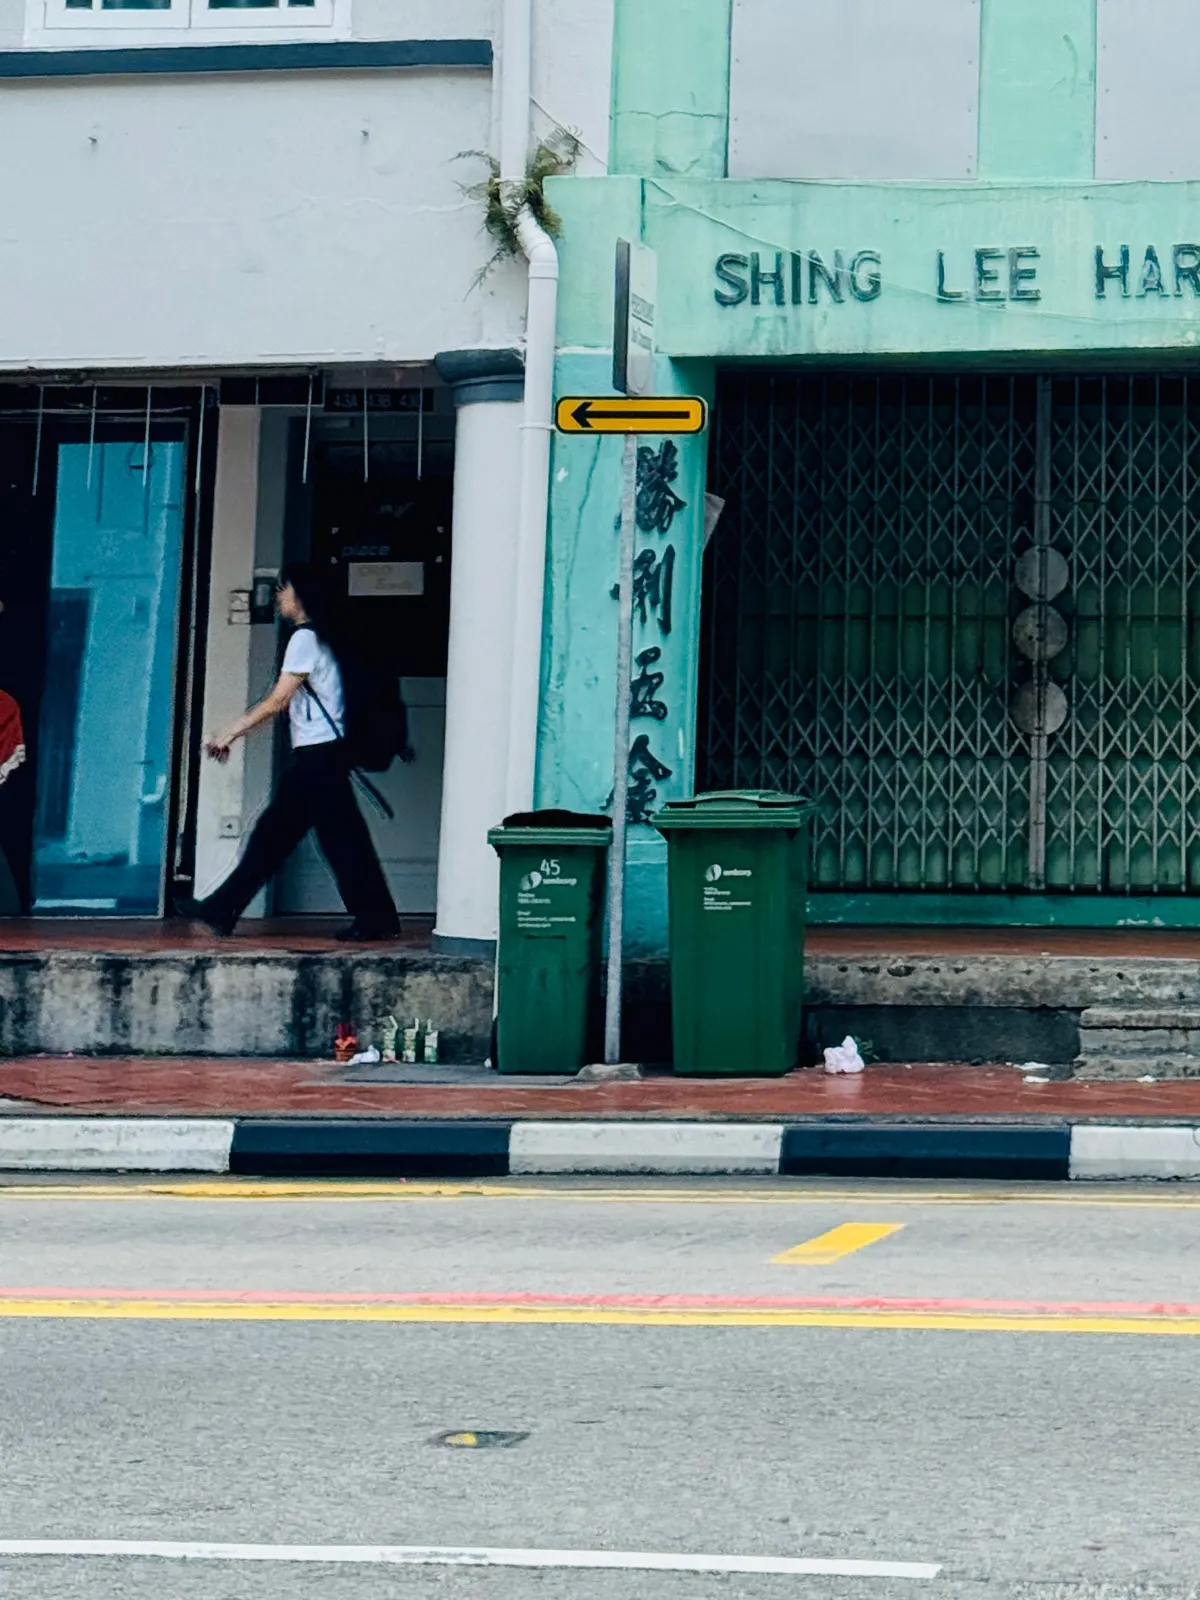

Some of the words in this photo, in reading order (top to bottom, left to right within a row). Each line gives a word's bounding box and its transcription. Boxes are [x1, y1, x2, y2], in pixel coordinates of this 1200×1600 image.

[714, 250, 881, 309] SHING
[936, 248, 1042, 305] LEE
[540, 858, 561, 876] 45
